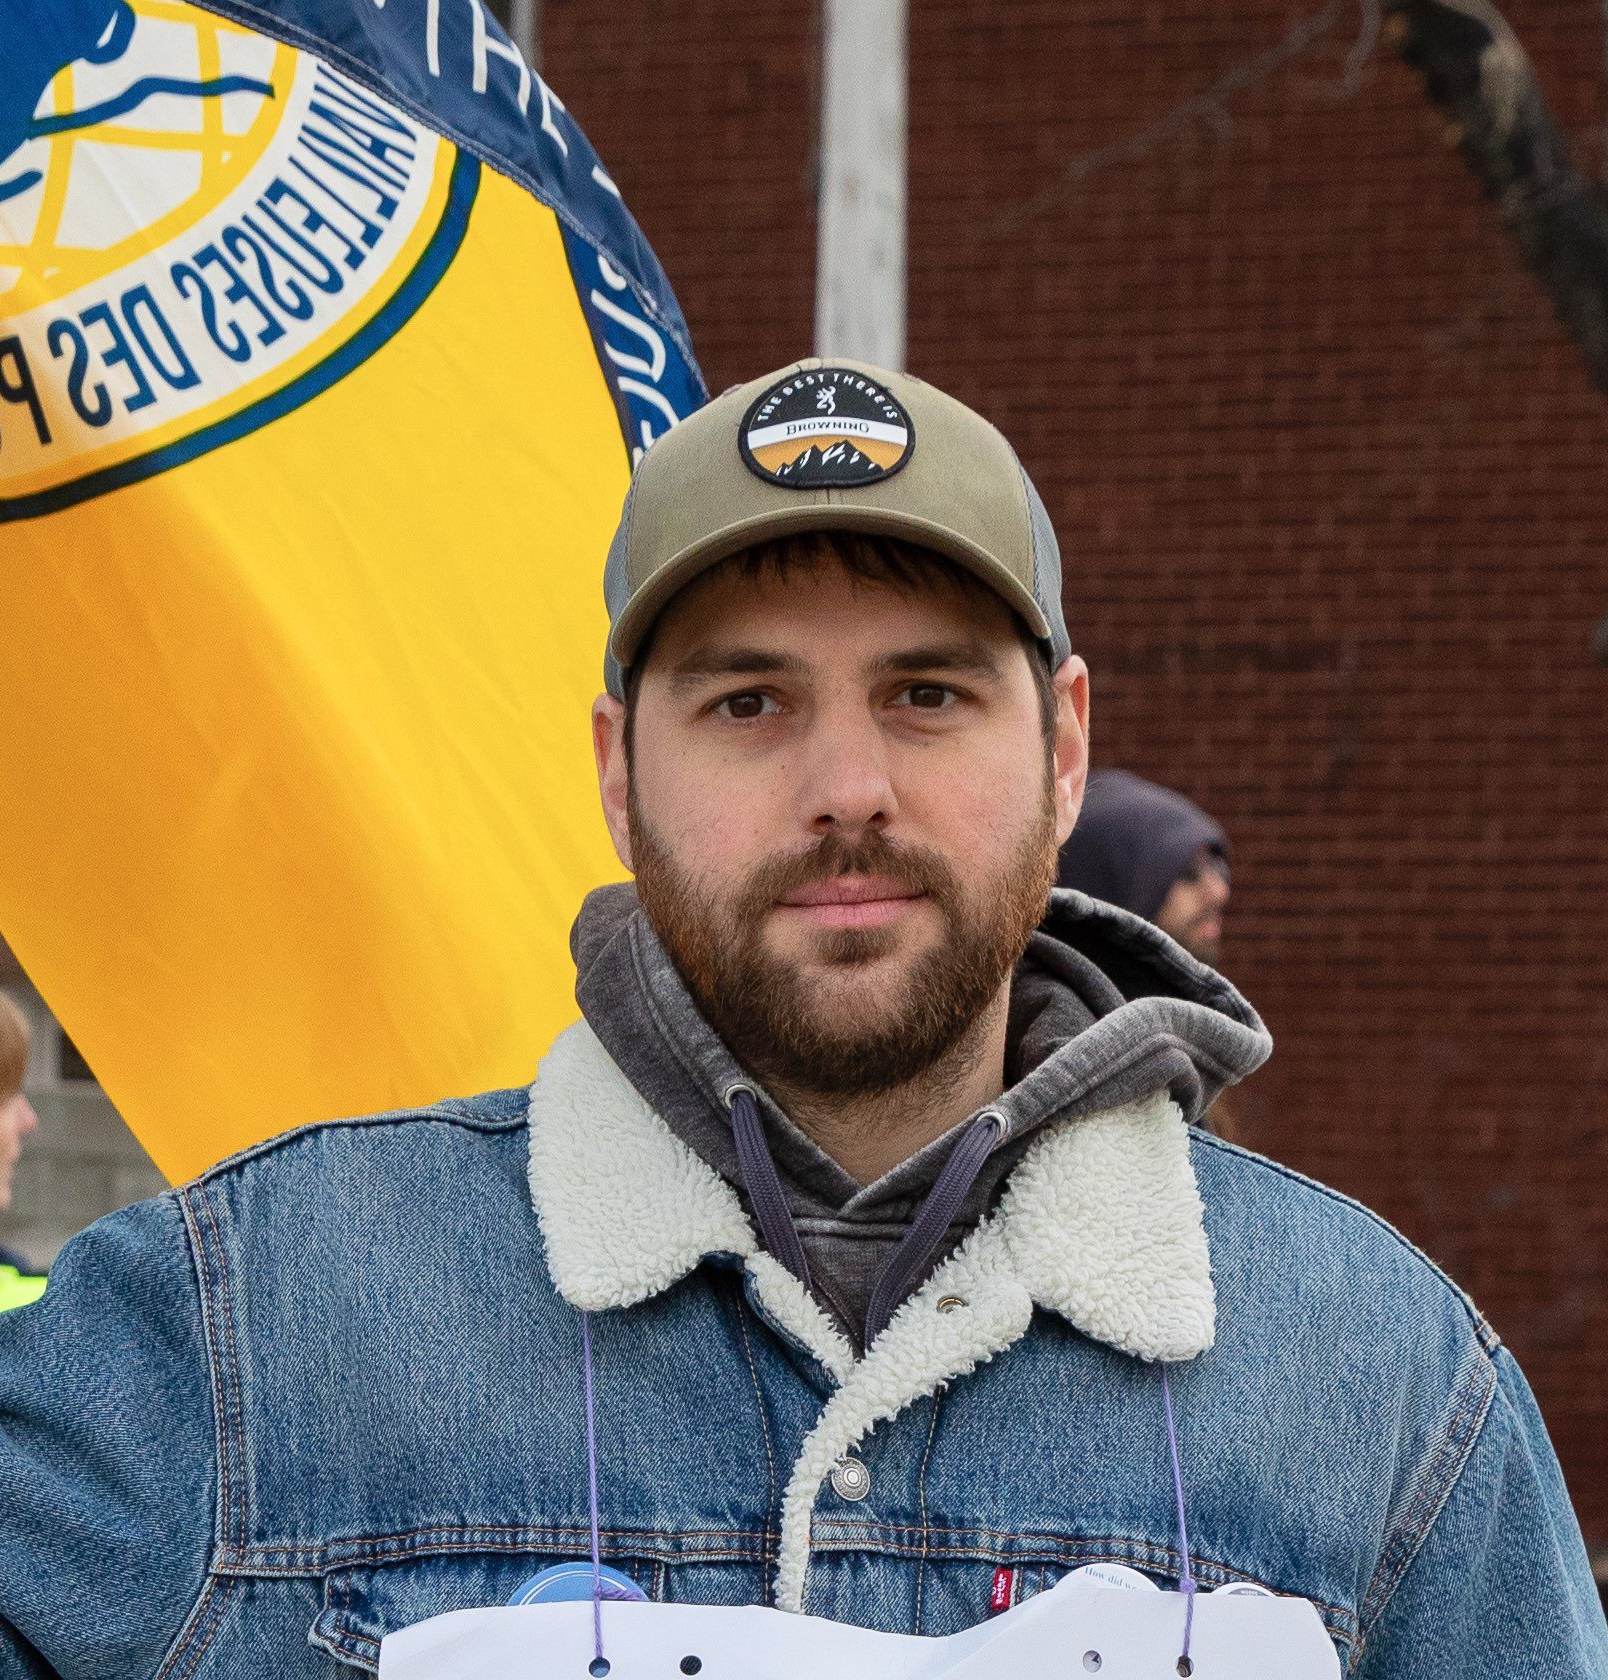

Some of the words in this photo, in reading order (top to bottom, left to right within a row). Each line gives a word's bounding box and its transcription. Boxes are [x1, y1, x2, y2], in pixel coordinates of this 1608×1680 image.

[757, 395, 782, 422] THE
[783, 373, 825, 396] BEST
[833, 373, 886, 404] THERE
[883, 405, 898, 419] IS
[1085, 1566, 1104, 1579] How
[1108, 1575, 1123, 1587] did
